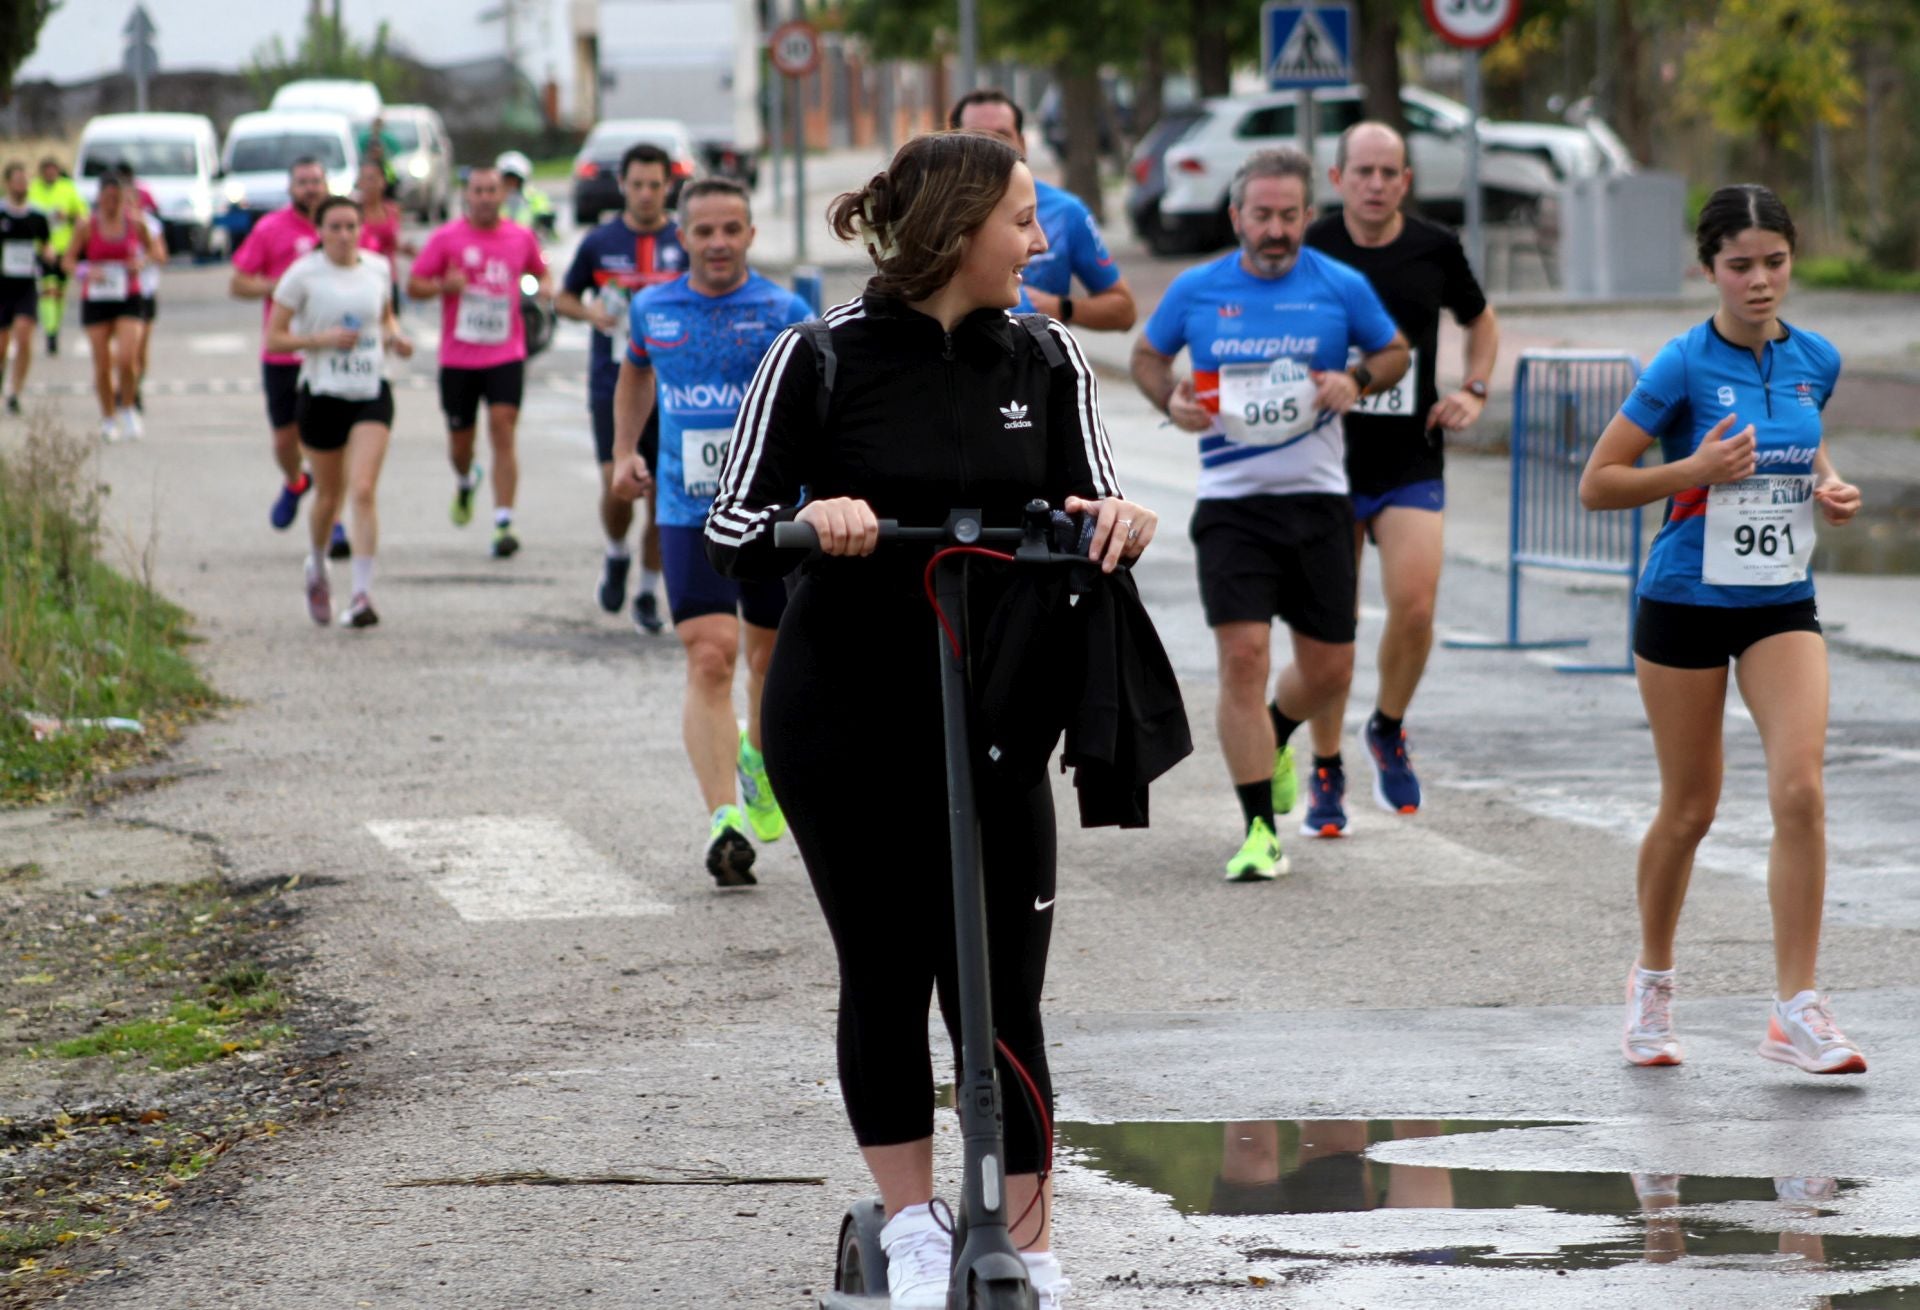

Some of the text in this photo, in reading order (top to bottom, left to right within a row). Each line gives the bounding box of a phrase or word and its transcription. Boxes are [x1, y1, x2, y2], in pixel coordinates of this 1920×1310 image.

[1211, 334, 1318, 358] enerplus
[1244, 397, 1299, 425] 965
[1004, 420, 1032, 429] adidas
[1734, 523, 1795, 556] 961
